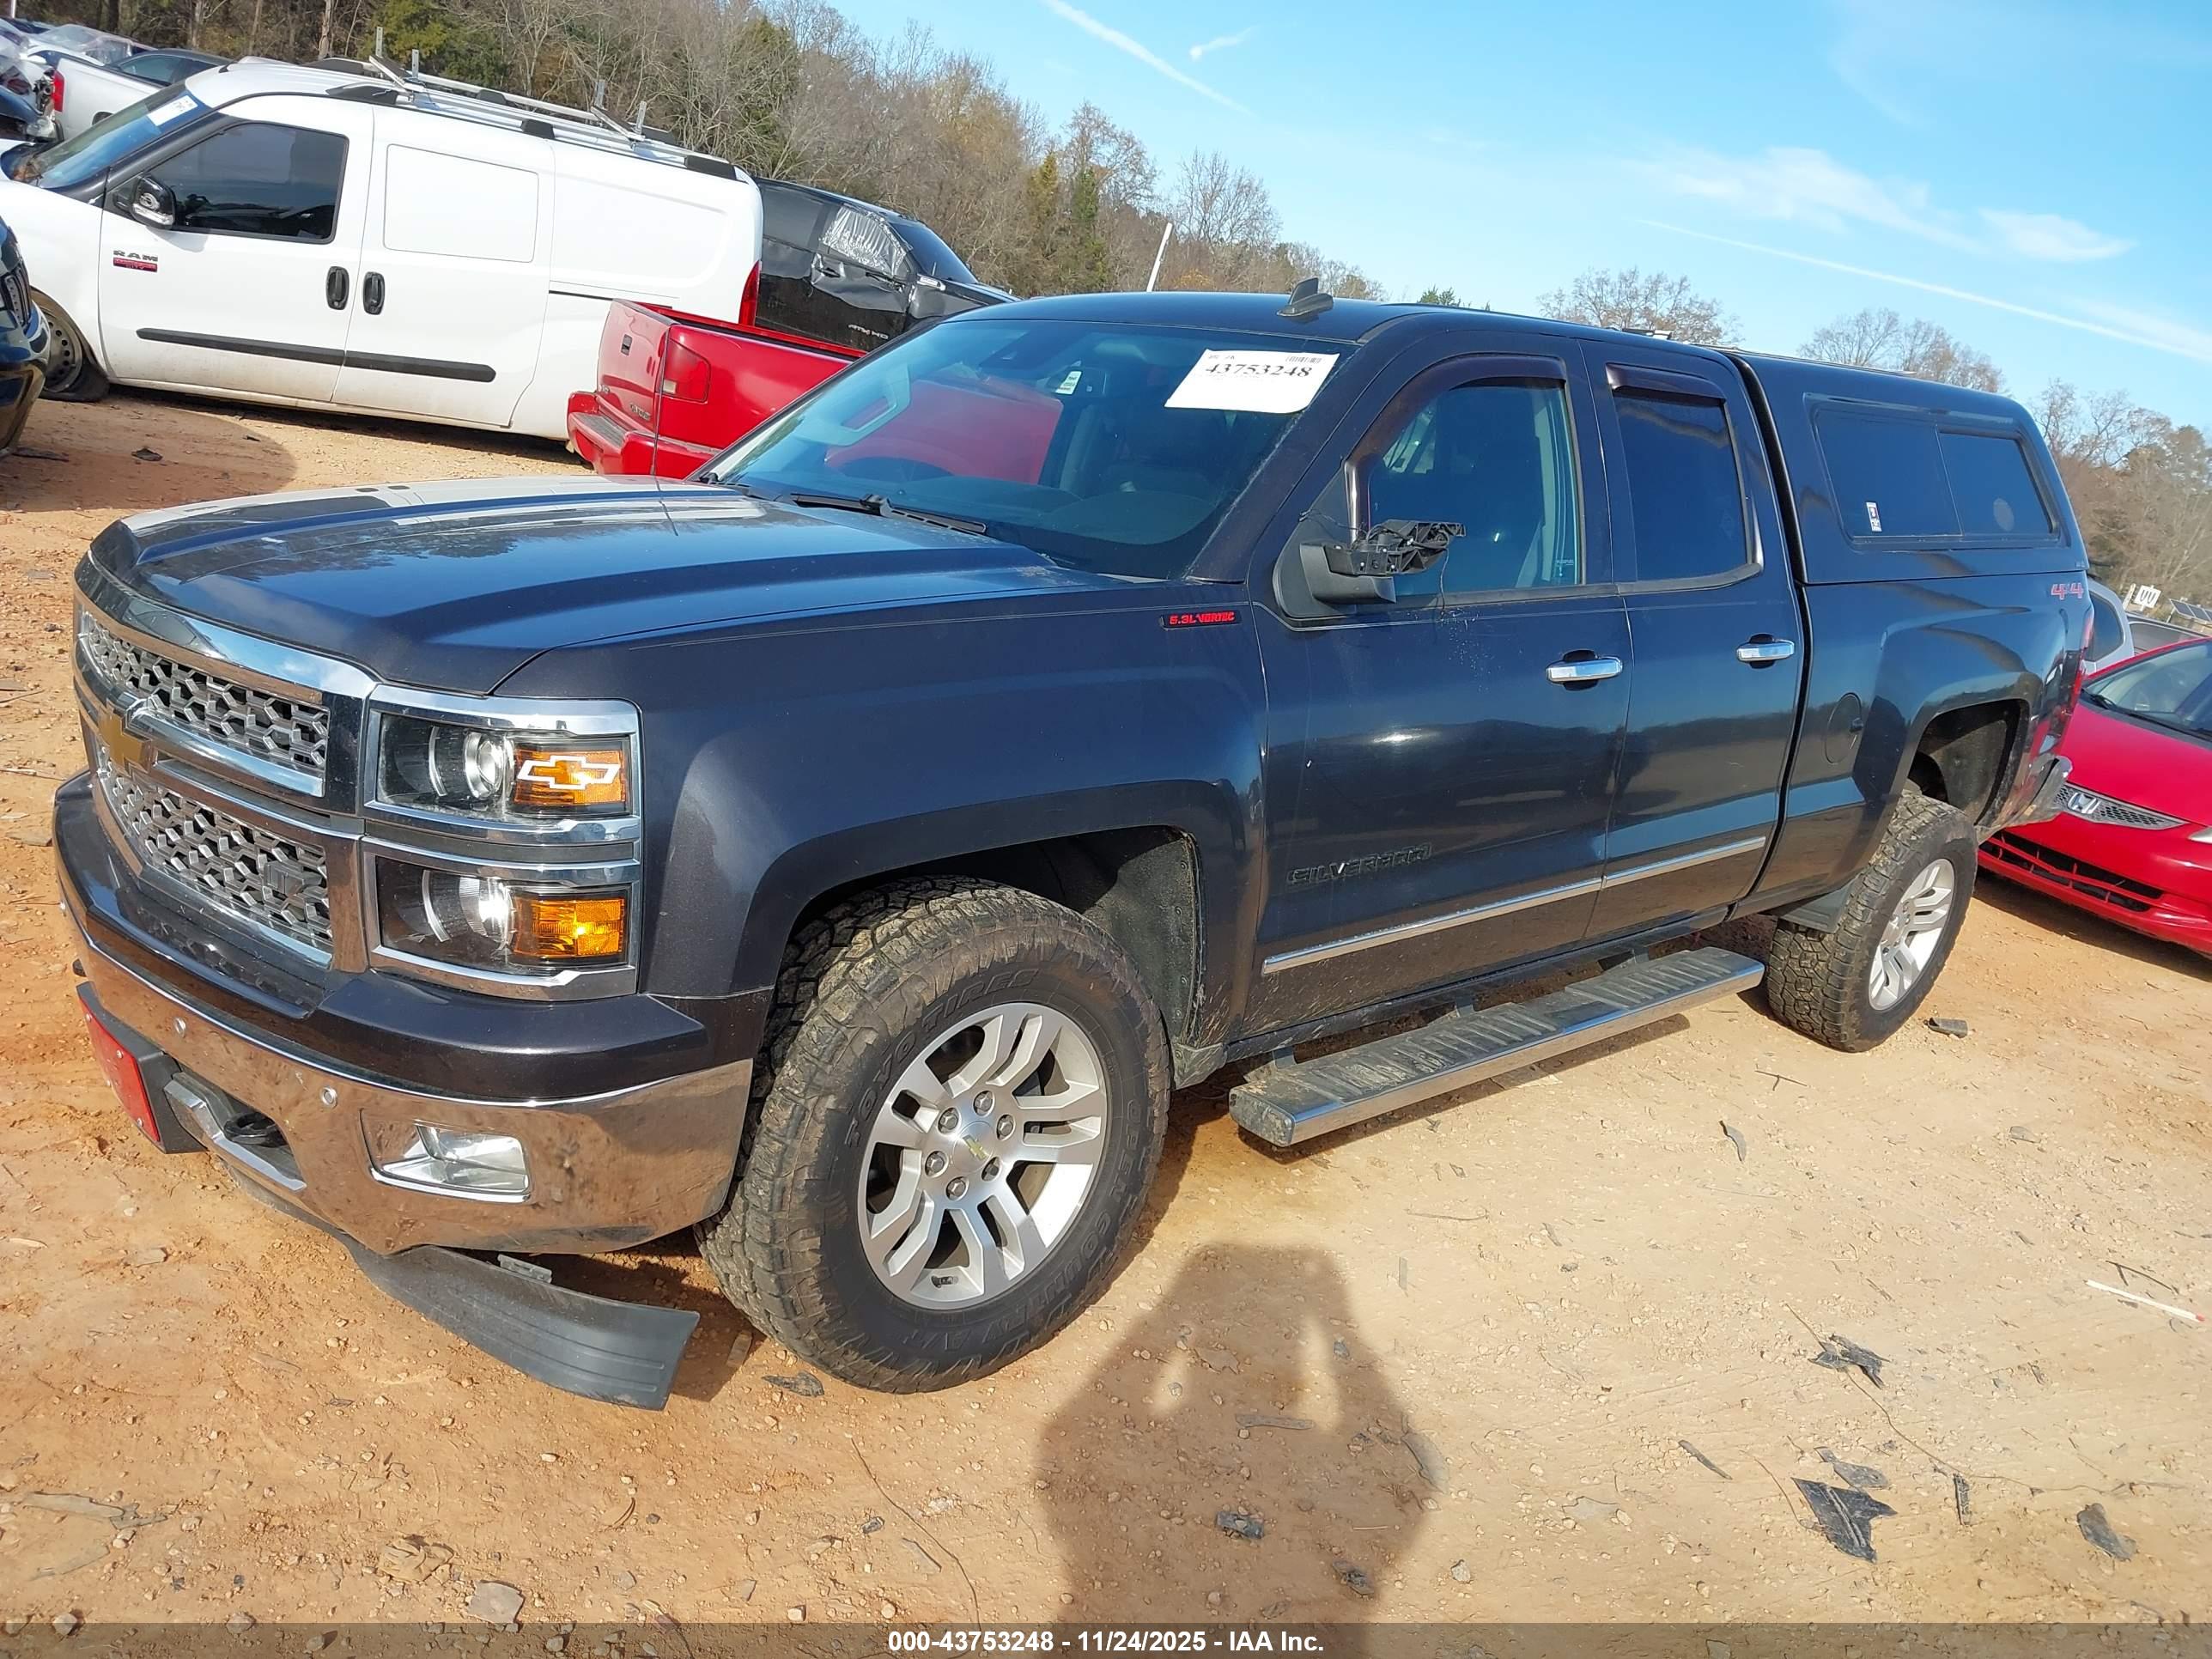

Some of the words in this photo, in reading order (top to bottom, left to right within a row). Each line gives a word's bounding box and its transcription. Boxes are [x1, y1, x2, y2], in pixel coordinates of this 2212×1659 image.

[113, 250, 159, 262] RAM
[1205, 363, 1313, 378] 43753248
[1194, 611, 1236, 623] VORTEC
[1287, 842, 1432, 884] SILVERADO
[844, 1030, 916, 1149] TOYO
[921, 967, 1042, 1030] TIRES
